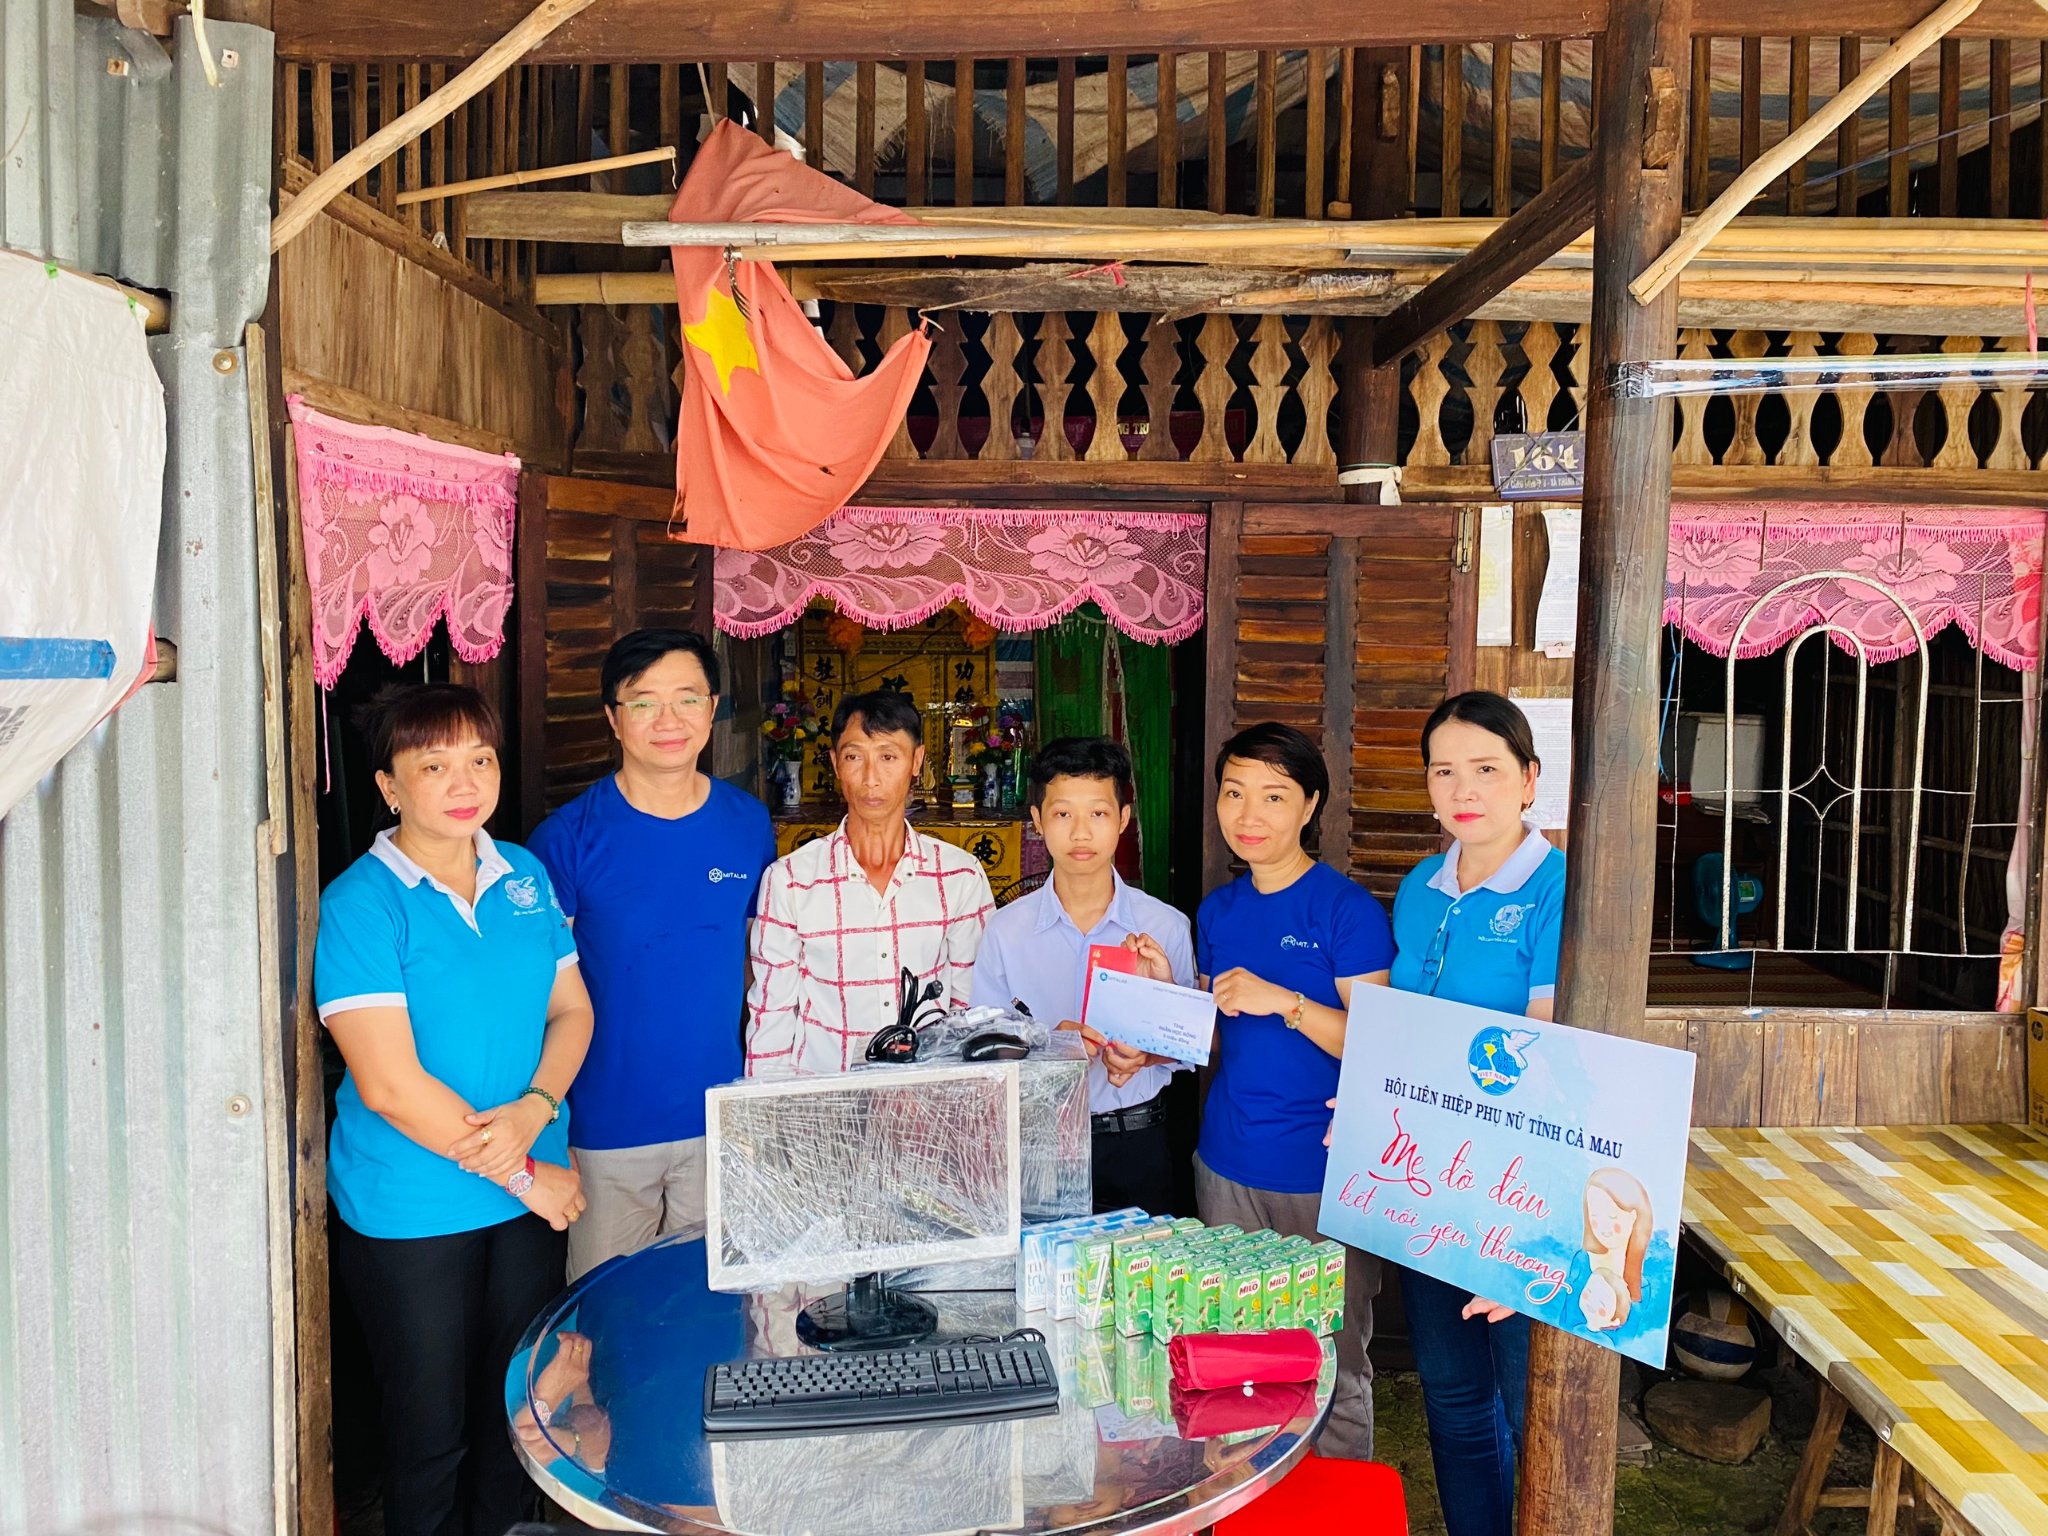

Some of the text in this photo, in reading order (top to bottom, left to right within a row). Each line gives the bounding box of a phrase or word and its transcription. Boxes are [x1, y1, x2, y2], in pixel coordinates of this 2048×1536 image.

[1510, 444, 1579, 471] 164
[1384, 1077, 1623, 1158] HỘI LIÊN HIỆP PHỤ NỮ TỈNH CÀ MAU
[1439, 1140, 1476, 1190] đỡ
[1488, 1156, 1551, 1219] đầu
[1339, 1173, 1572, 1304] kết nối yêu thương
[1130, 1260, 1150, 1272] MILO
[1326, 1260, 1343, 1273] MILO
[1299, 1268, 1316, 1279] MILO
[1269, 1276, 1288, 1289] MILO
[1239, 1283, 1258, 1296] MILO
